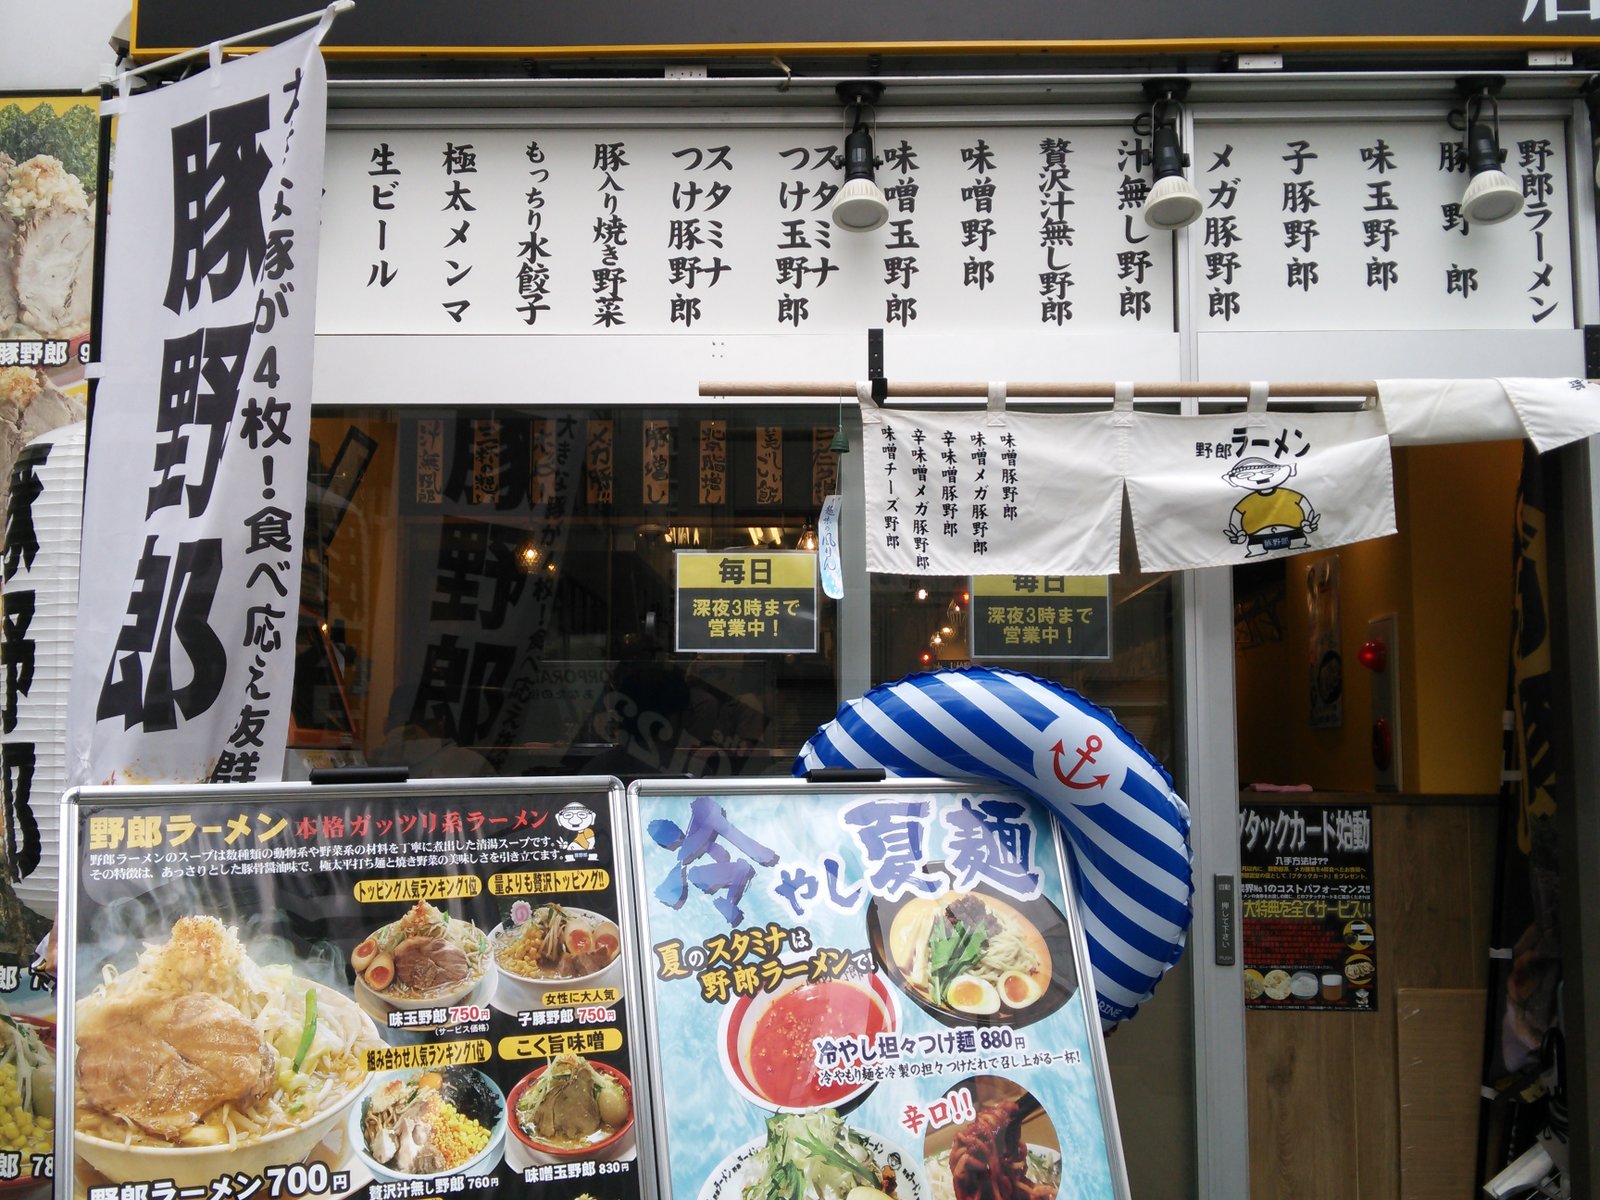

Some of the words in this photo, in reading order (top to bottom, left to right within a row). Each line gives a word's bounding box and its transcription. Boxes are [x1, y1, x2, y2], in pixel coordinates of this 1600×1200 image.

[368, 142, 401, 287] 生ビール
[442, 142, 478, 323] 極太メンマ
[516, 140, 551, 325] もっちり水餃子
[592, 141, 630, 328] 豚入り焼き野菜
[668, 144, 703, 327] つけ豚野郎
[702, 145, 734, 288] スタミナ
[775, 144, 812, 327] つけ玉野郎
[810, 145, 840, 288] スタミナ
[883, 141, 919, 327] 味噌玉野郎
[960, 138, 997, 291] 味噌野郎
[1038, 137, 1075, 327] 贅沢汁無し野郎
[1117, 138, 1153, 322] 汁無し野郎
[1204, 143, 1242, 321] メガ豚野郎
[1282, 140, 1319, 292] 子豚野郎
[1359, 138, 1398, 291] 味玉野郎
[1517, 139, 1558, 323] 野郎ラーメン
[0, 341, 68, 365] 豚野郎
[97, 94, 273, 733] 豚野郎
[881, 425, 900, 549] 味噌チーズ野郎
[911, 428, 931, 570] 辛味噌メガ豚野郎
[941, 431, 959, 537] 辛味噌豚野郎
[970, 431, 989, 556] 味噌メガ豚野郎
[1000, 432, 1018, 520] 味噌豚野郎
[1195, 427, 1312, 460] 野郎ラーメン
[692, 599, 800, 617] 深夜3時まで
[718, 558, 772, 585] 毎日
[987, 606, 1094, 626] 深夜3時まで
[1013, 576, 1065, 593] 毎日
[89, 813, 288, 850] 野郎ラーメン
[296, 809, 549, 839] 本格ガッツリ系ラーメン
[647, 796, 1042, 928] 冷やし夏麺
[545, 989, 615, 1005] 女性に大人気
[658, 927, 809, 977] 夏のスタミナは
[1097, 1000, 1122, 1017] RINE
[389, 1008, 447, 1027] 味玉野郎
[450, 1007, 490, 1022] 750円
[517, 1032, 604, 1056] こく旨味噌
[518, 1008, 573, 1026] 子豚野郎
[578, 1007, 616, 1022] 750円
[981, 1030, 1025, 1049] 880円
[267, 1165, 350, 1197] 700円
[369, 1178, 465, 1200] 贅沢汁無し野郎
[468, 1177, 499, 1189] 760円
[525, 1161, 596, 1183] 味噌玉野郎
[599, 1162, 630, 1174] 830円
